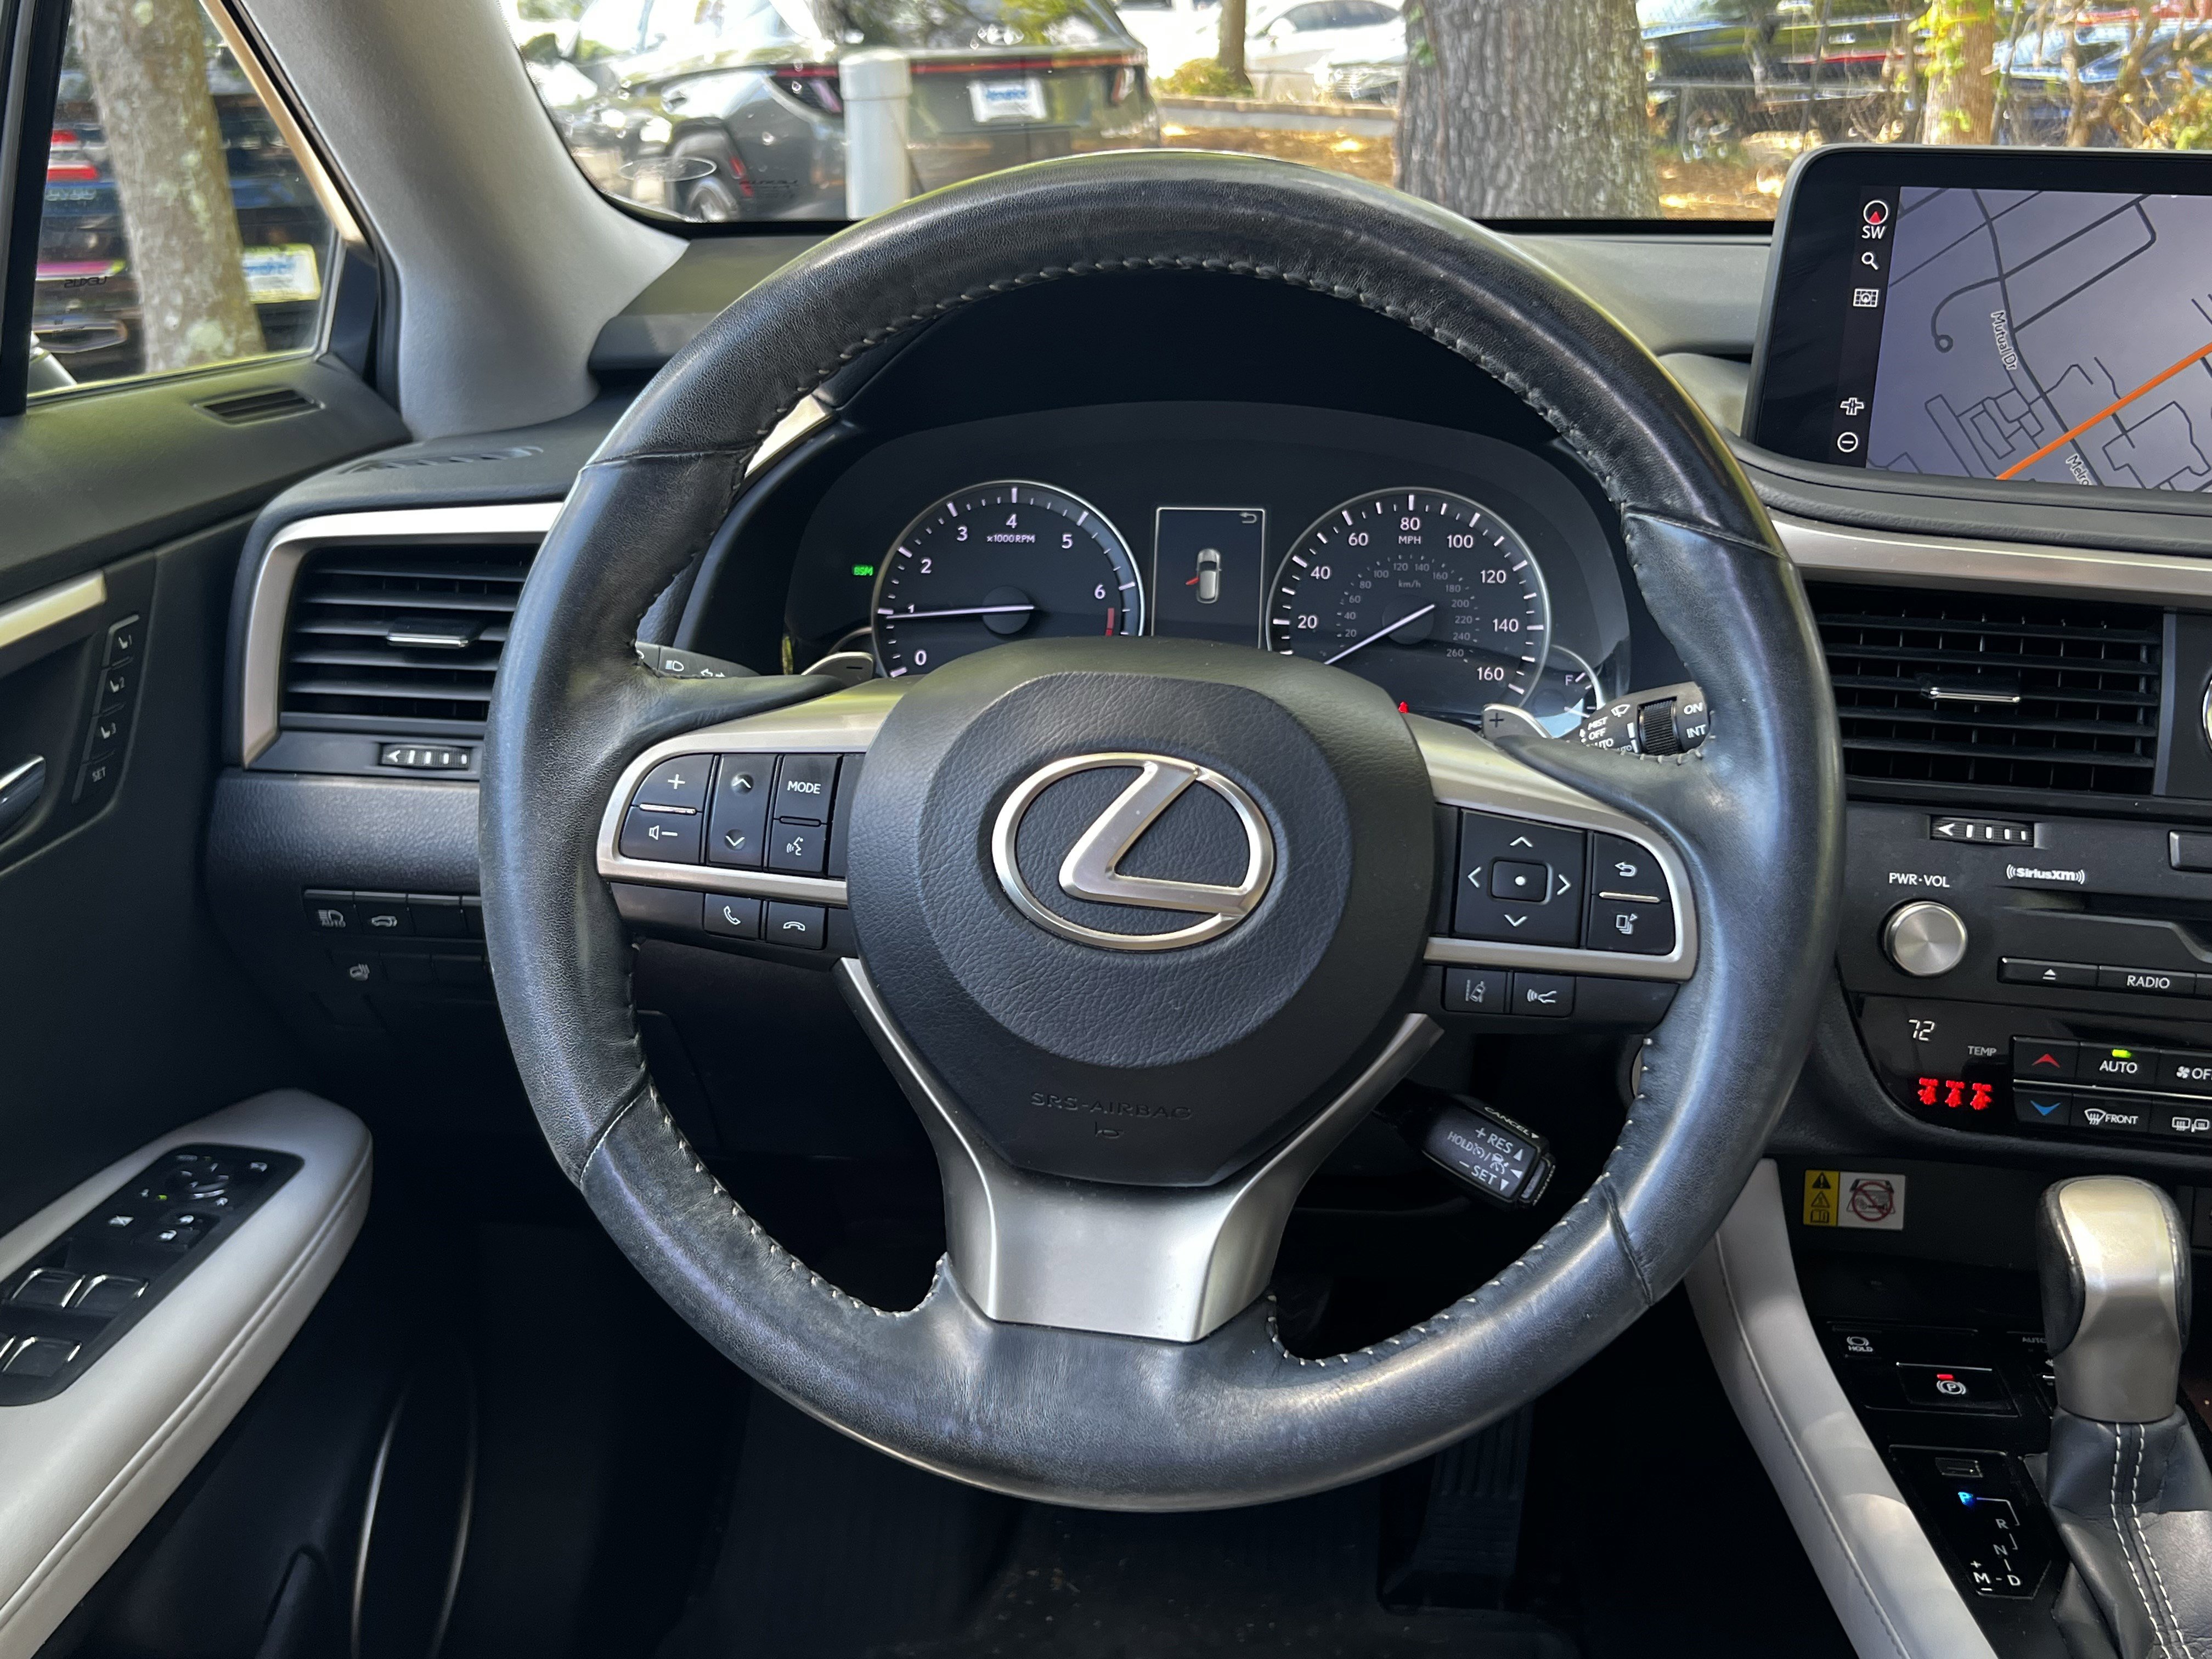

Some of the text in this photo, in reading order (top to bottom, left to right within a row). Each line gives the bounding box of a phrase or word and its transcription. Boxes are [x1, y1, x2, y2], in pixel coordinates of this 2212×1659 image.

[1861, 225, 1886, 239] SW
[1992, 311, 2017, 369] Mutual Dr
[1006, 514, 1018, 528] 4
[1400, 517, 1420, 531] 80
[957, 527, 968, 541] 3
[1348, 533, 1368, 546] 60
[1398, 535, 1421, 545] MPH
[1062, 534, 1073, 549] 5
[1447, 535, 1473, 549] 100
[921, 560, 932, 574] 2
[1311, 566, 1331, 580] 40
[1393, 563, 1408, 571] 120
[1414, 563, 1430, 572] 140
[1373, 570, 1389, 578] 100
[1432, 572, 1448, 580] 160
[1481, 570, 1506, 584] 120
[1359, 580, 1372, 589] 80
[1398, 580, 1421, 588] km/h
[1446, 584, 1462, 592] 180
[1094, 585, 1105, 599] 6
[1348, 595, 1361, 603] 60
[1451, 599, 1470, 608] 200
[1297, 615, 1317, 629] 20
[1344, 612, 1357, 620] 40
[1454, 615, 1472, 624] 220
[1492, 619, 1519, 633] 140
[1345, 629, 1357, 637] 20
[1452, 631, 1470, 641] 240
[915, 650, 927, 666] 0
[1446, 648, 1464, 658] 260
[1477, 667, 1504, 681] 160
[1565, 675, 1573, 685] F
[1683, 702, 1703, 715] ON
[1587, 716, 1608, 730] MIST
[1588, 727, 1606, 740] OFF
[1686, 724, 1707, 738] INT
[92, 766, 105, 782] SET
[787, 781, 822, 794] MODE
[2126, 975, 2170, 989] RADIO
[1908, 1019, 1936, 1041] 72
[1967, 1045, 1997, 1057] TEMP
[2099, 1060, 2138, 1074] AUTO
[2192, 1067, 2212, 1080] OF
[2105, 1113, 2138, 1125] FRONT
[1447, 1131, 1474, 1152] HOLD
[1995, 1518, 2010, 1530] R
[1993, 1544, 2008, 1556] N
[2007, 1574, 2021, 1587] D
